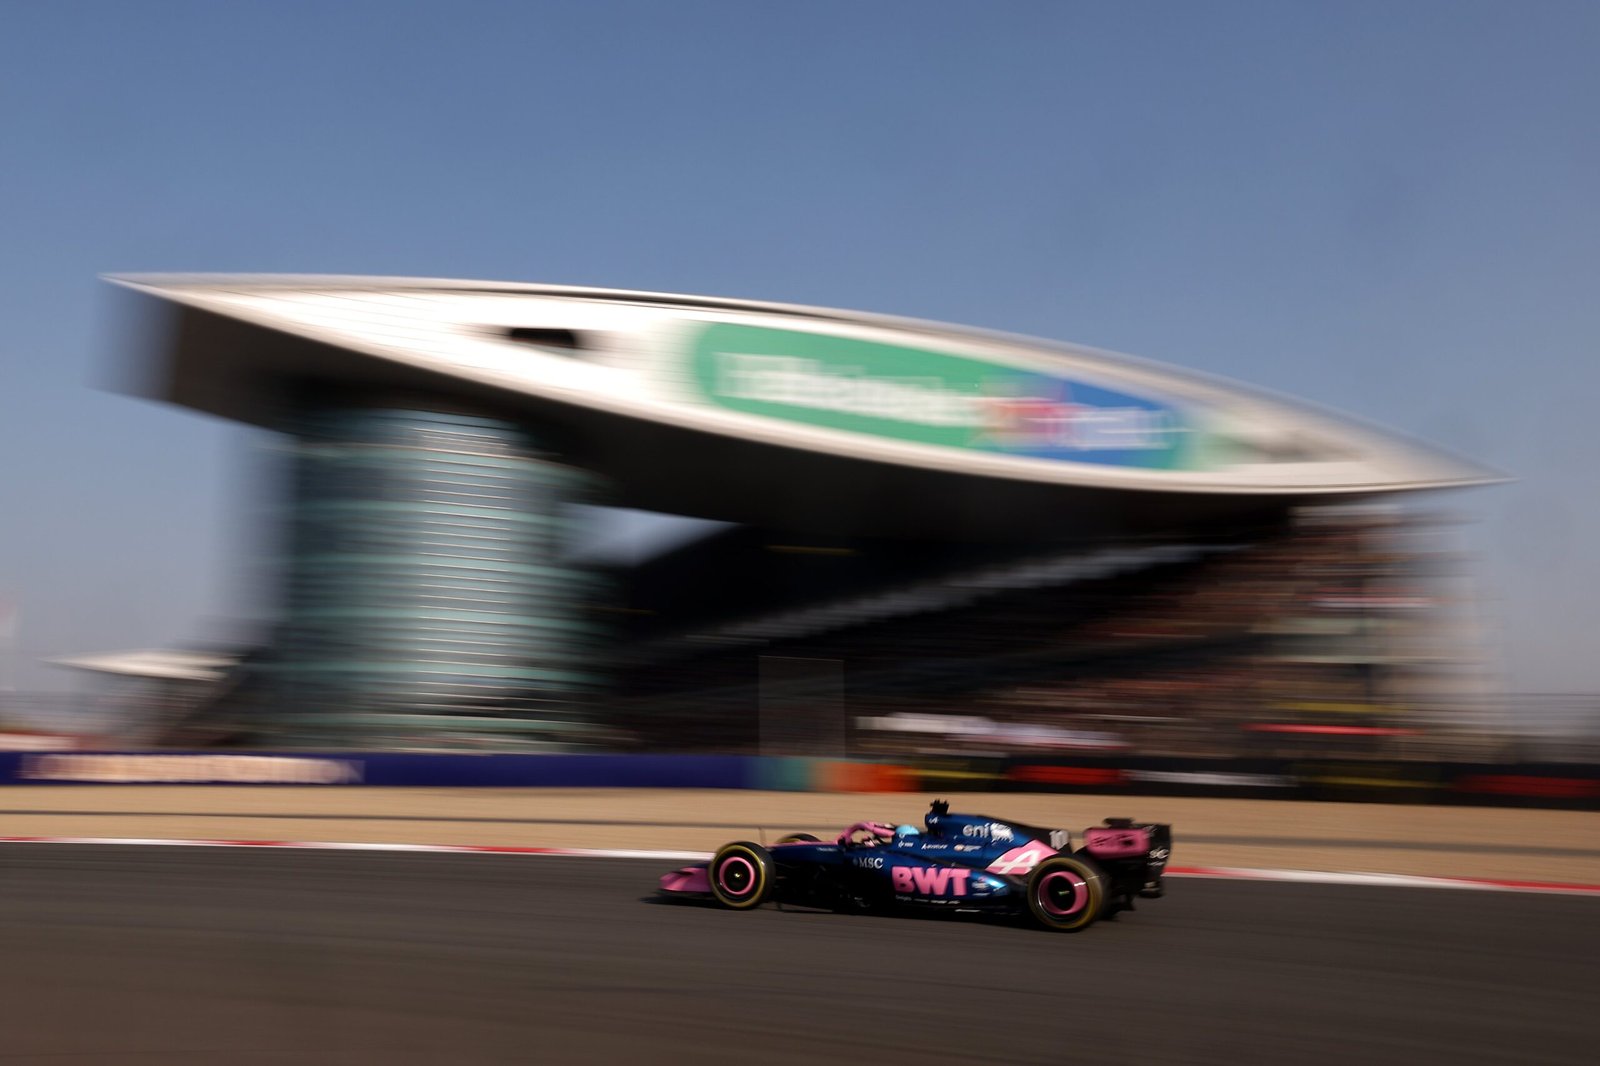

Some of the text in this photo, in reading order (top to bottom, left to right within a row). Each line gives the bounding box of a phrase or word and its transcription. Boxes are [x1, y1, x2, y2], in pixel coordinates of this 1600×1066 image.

[962, 822, 990, 838] eni
[859, 857, 883, 869] MSC
[891, 866, 971, 896] BWT
